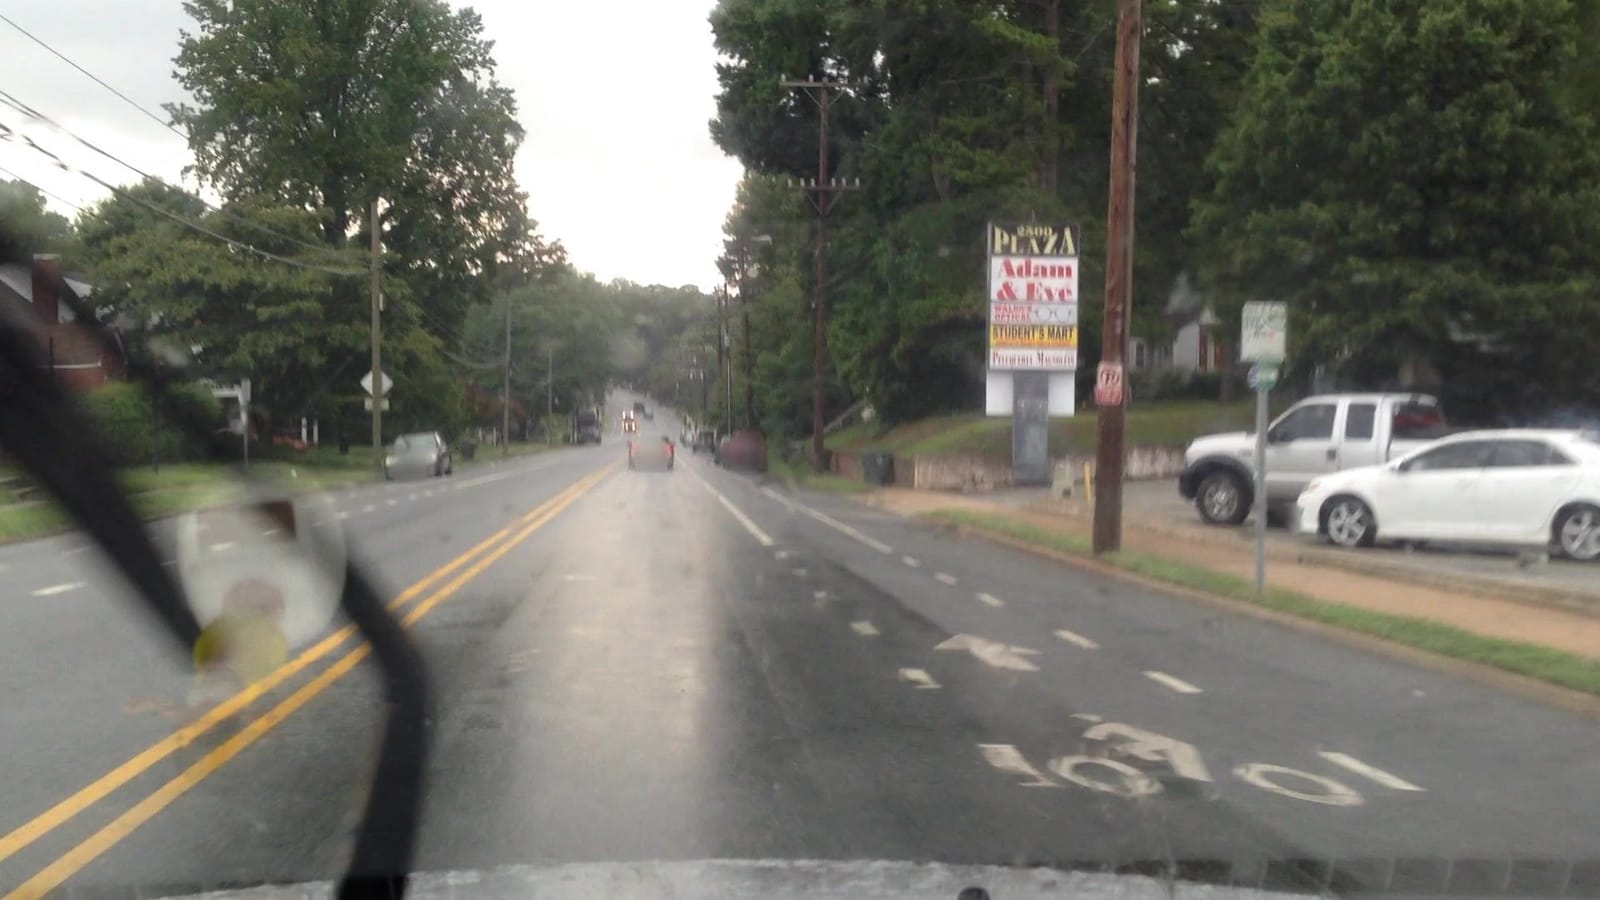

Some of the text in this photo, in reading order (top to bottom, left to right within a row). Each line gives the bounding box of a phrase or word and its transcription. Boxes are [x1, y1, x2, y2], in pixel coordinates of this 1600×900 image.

[994, 225, 1076, 254] PLAZA
[997, 256, 1072, 277] Adam
[996, 281, 1072, 301] & Eve
[992, 325, 1073, 339] STUDENT'S MART
